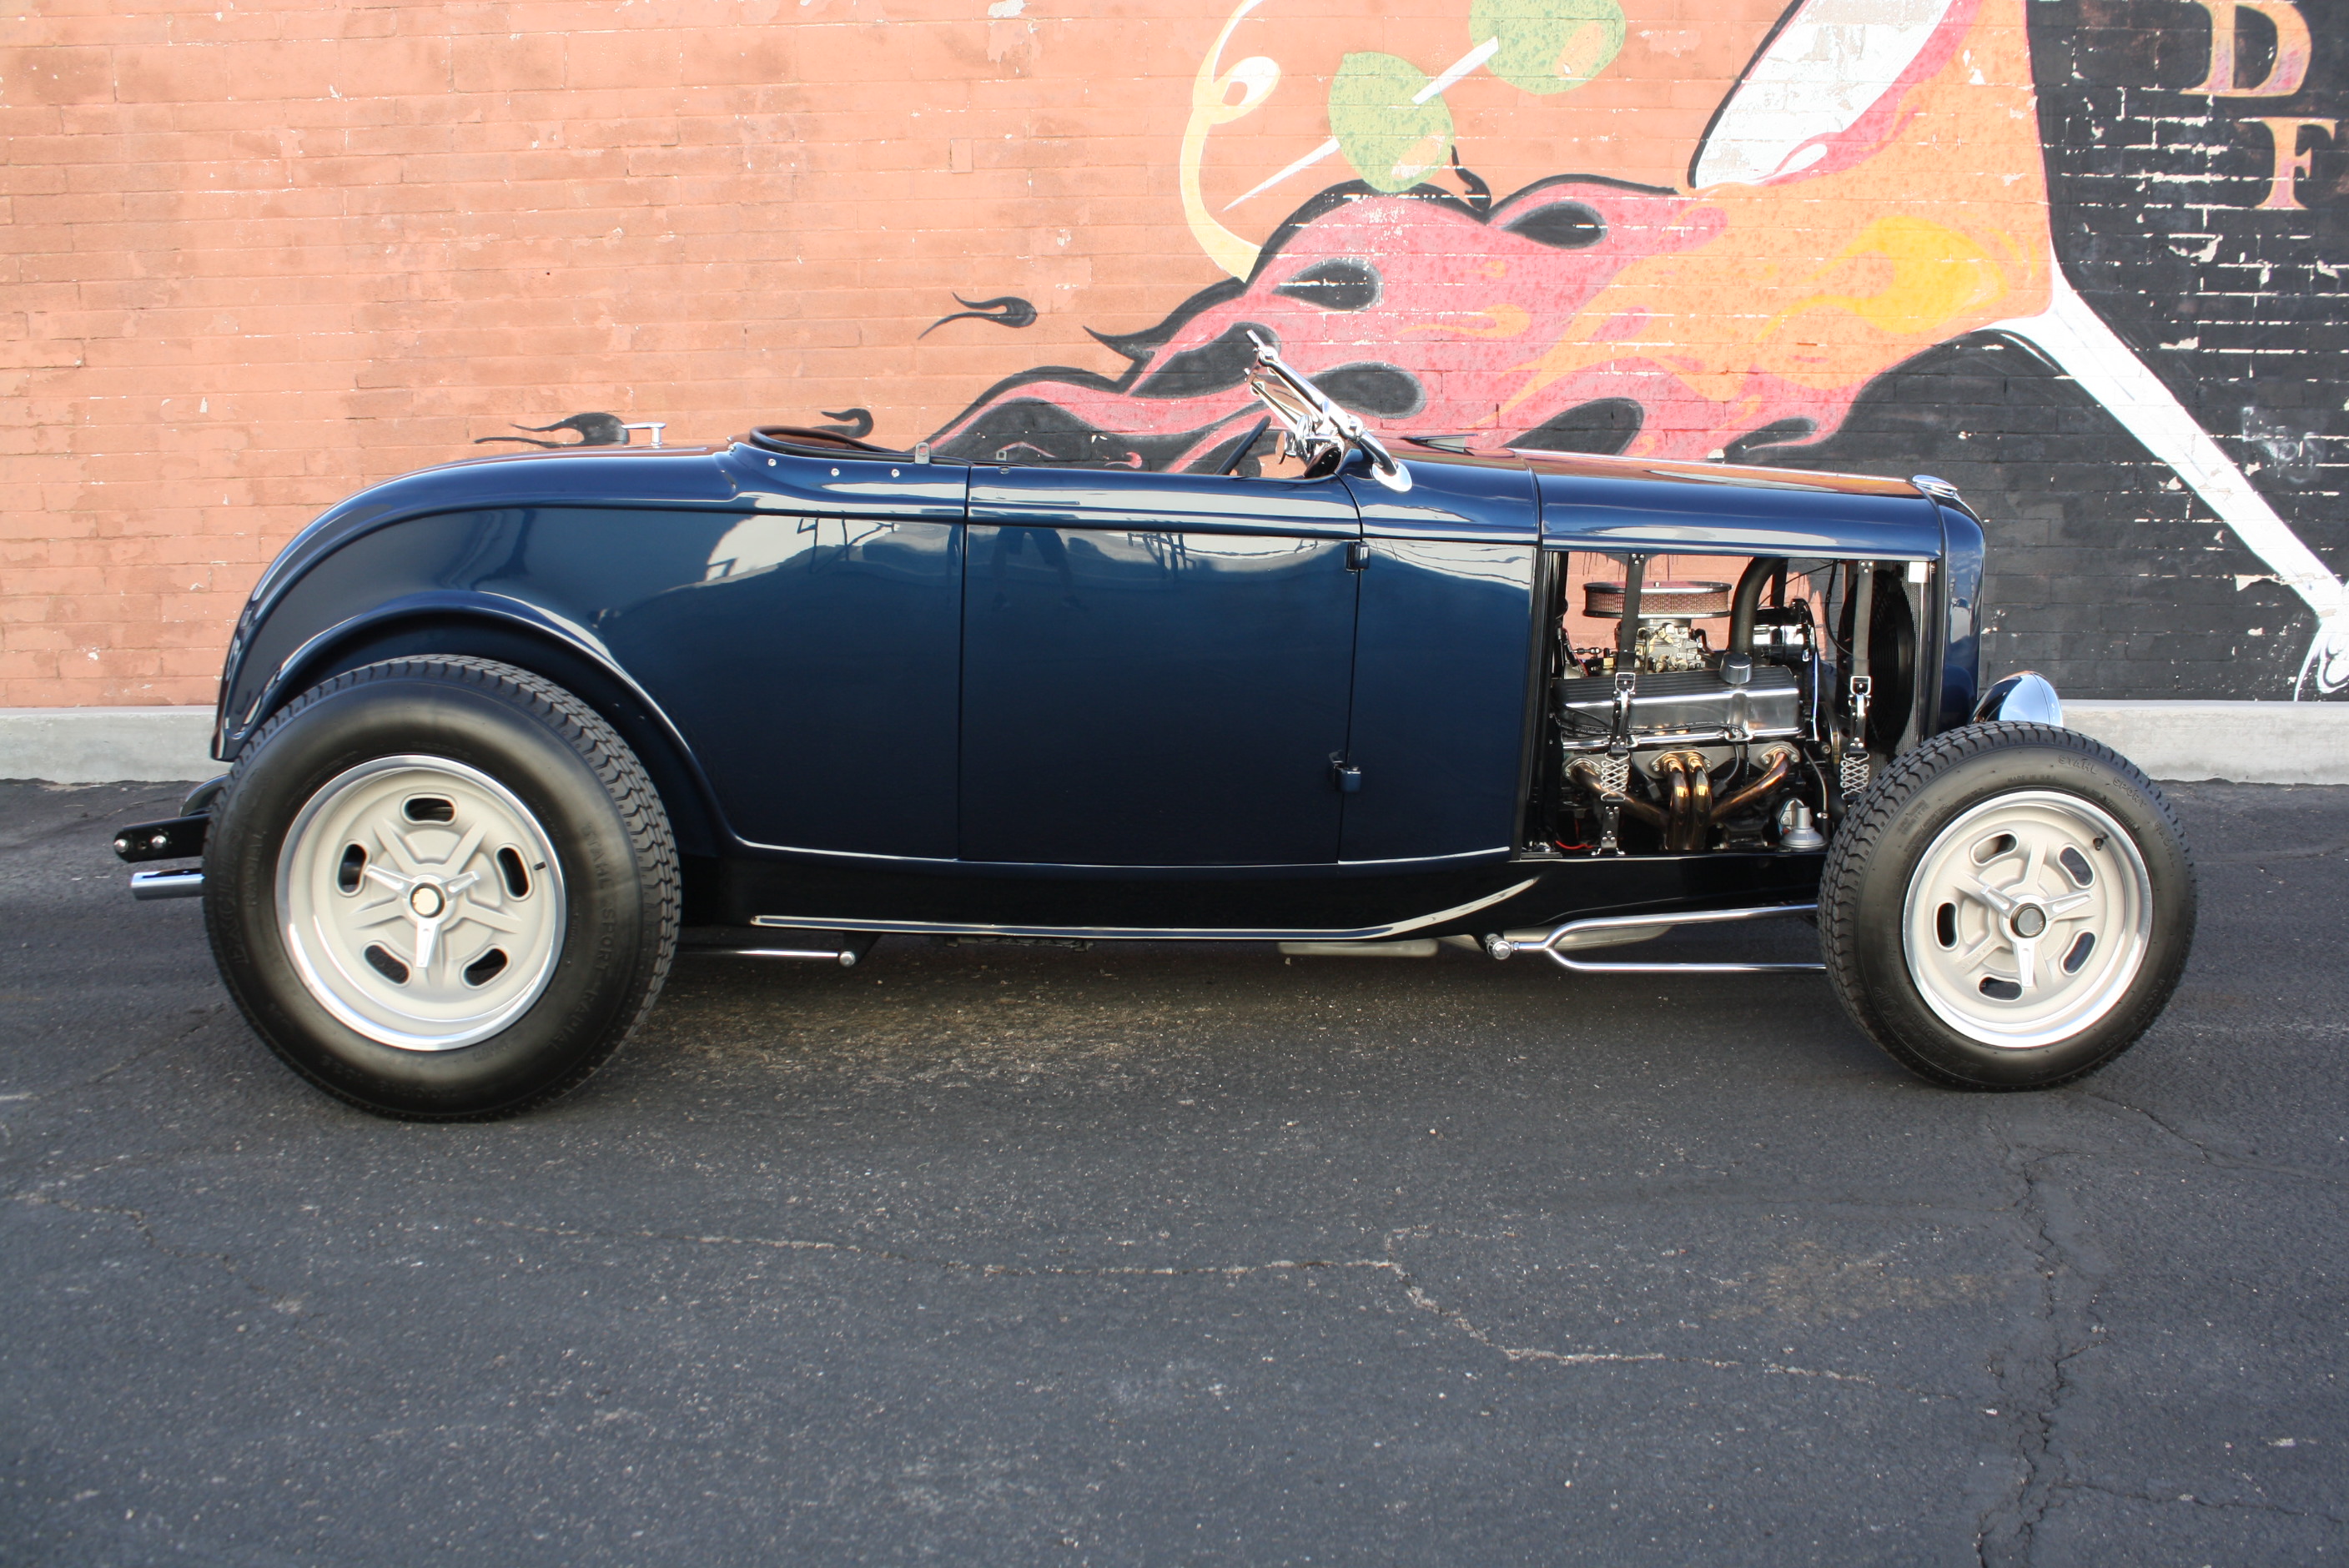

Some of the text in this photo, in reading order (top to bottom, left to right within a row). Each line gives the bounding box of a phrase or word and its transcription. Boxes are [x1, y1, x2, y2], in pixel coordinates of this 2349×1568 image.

[2179, 0, 2311, 97] D
[2255, 117, 2336, 210] F
[2058, 755, 2099, 775] STAHL
[2112, 776, 2147, 808] SPORT
[581, 821, 613, 890] STAHL
[593, 906, 616, 976] SPORT
